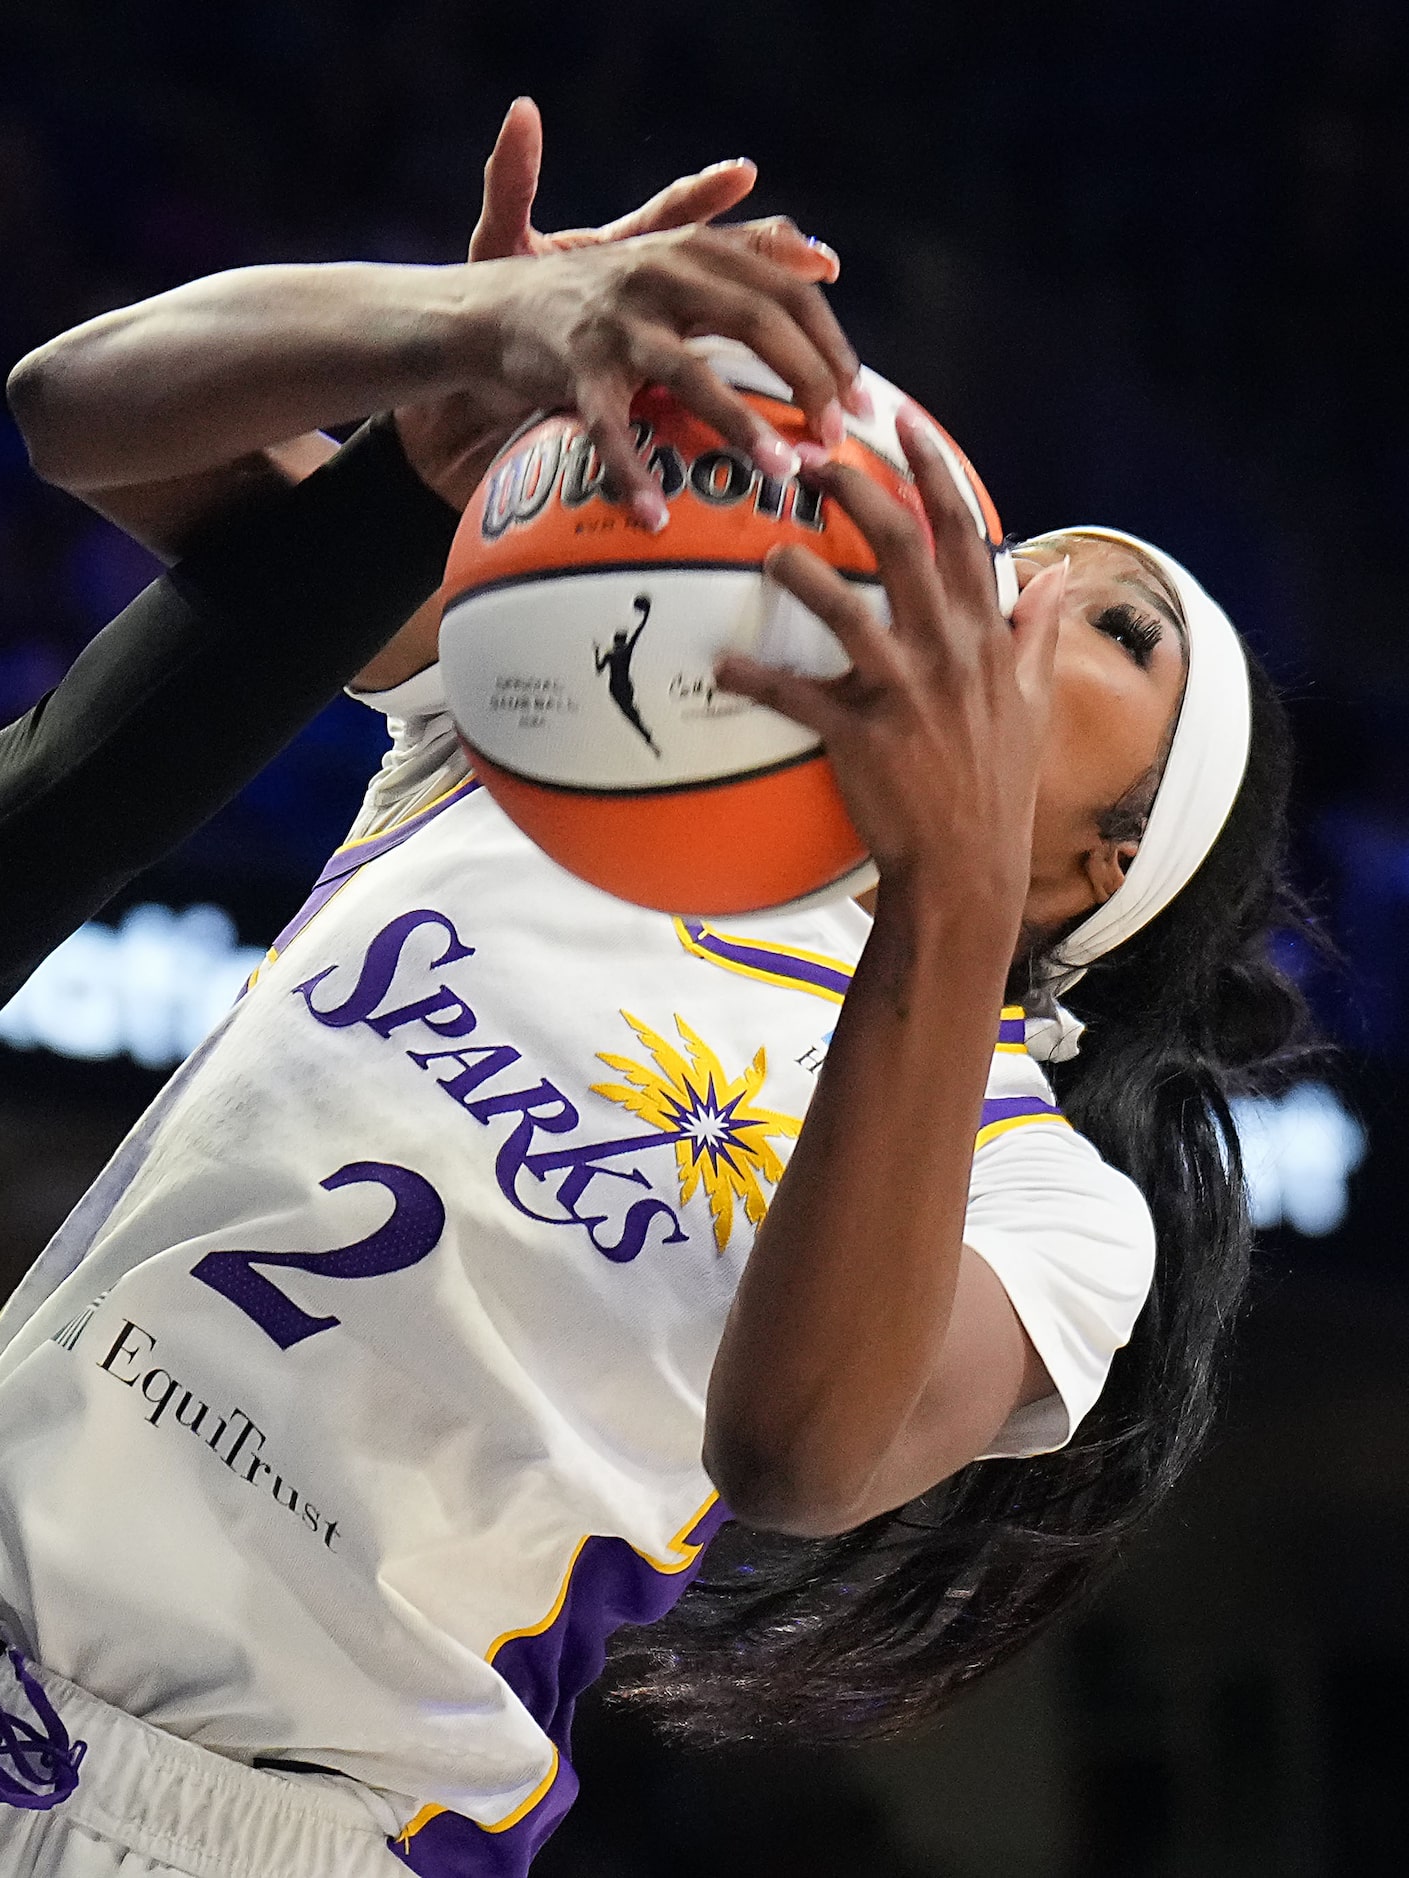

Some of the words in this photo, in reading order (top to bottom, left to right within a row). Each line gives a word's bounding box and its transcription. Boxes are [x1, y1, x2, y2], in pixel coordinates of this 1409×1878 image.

[481, 421, 826, 542] Wison
[189, 1160, 446, 1352] 2
[96, 1317, 342, 1554] EquiTrust
